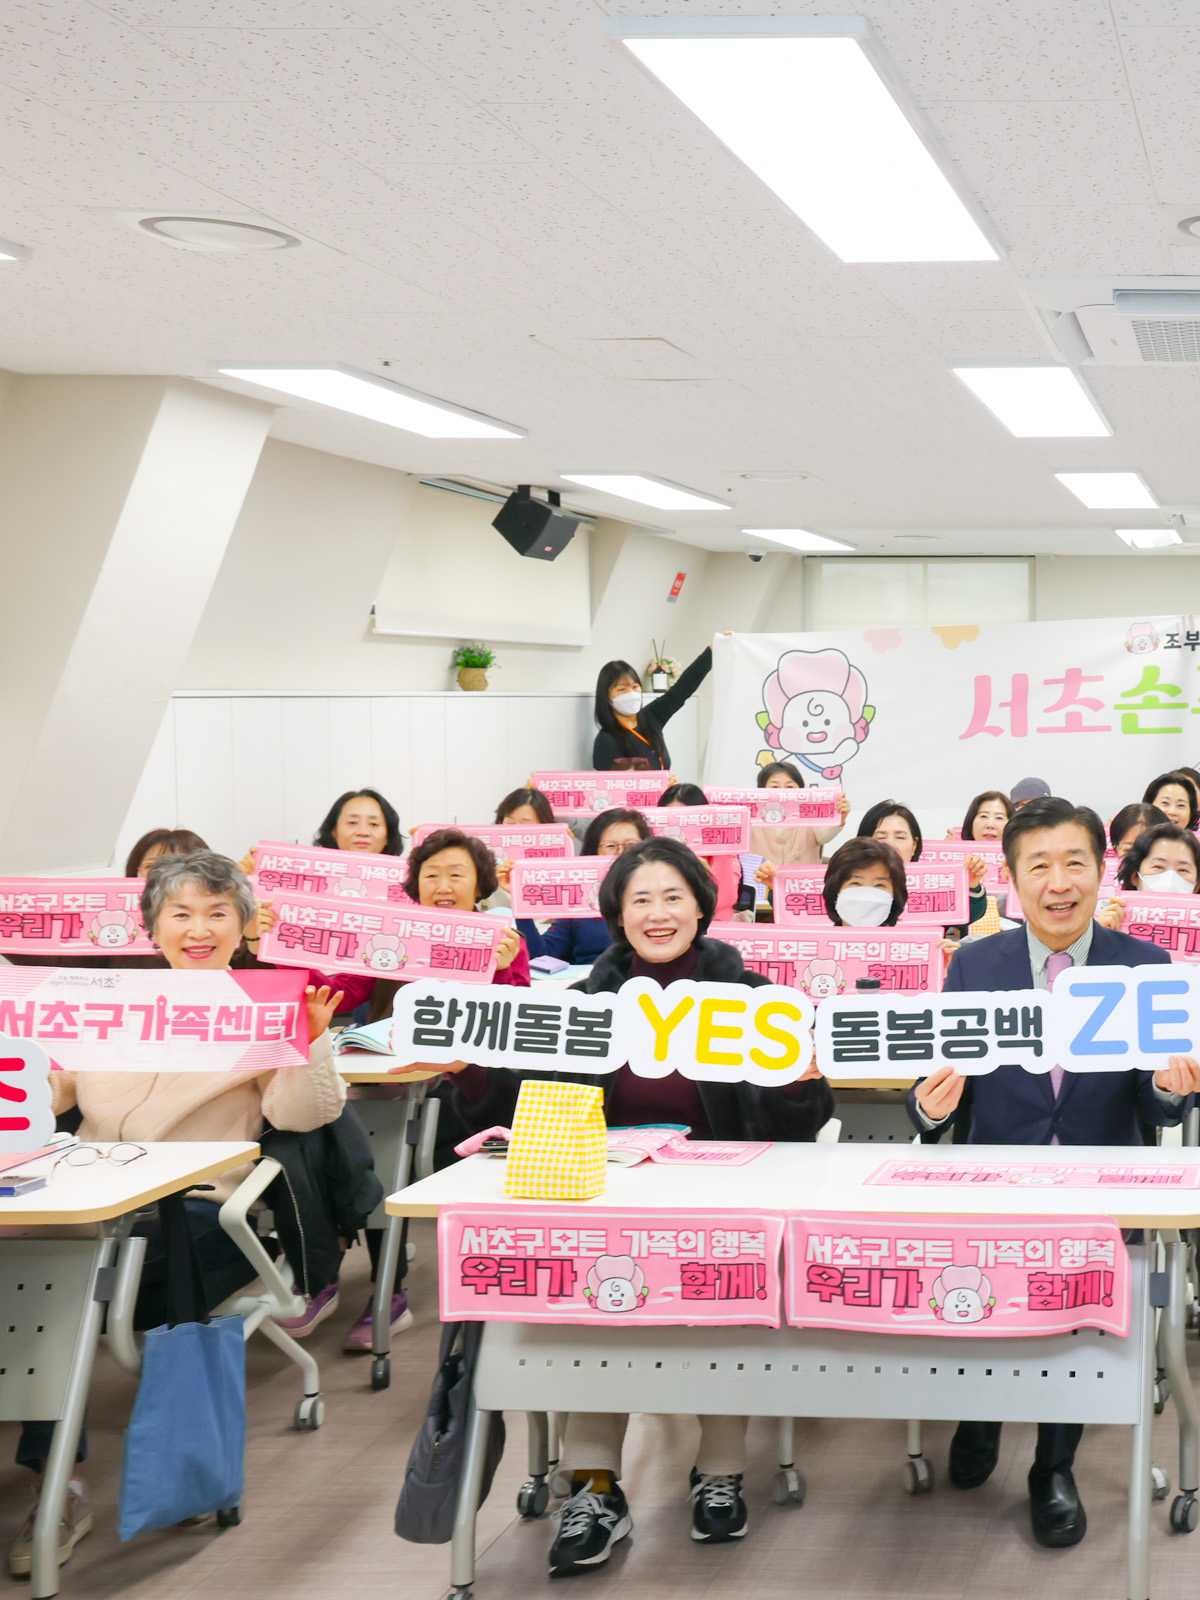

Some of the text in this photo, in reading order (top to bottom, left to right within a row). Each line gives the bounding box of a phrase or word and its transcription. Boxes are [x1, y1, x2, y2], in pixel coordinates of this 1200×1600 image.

[538, 780, 662, 791] 서초구 모든 가족의 행복
[711, 790, 835, 803] 서초구 모든 가족의 행복
[677, 814, 714, 827] 가족의
[716, 812, 742, 826] 행복
[800, 802, 836, 818] 함께!
[498, 834, 537, 847] 가족의
[540, 834, 565, 847] 행복
[702, 827, 742, 844] 함께!
[260, 854, 404, 880] 서초구 모든 가족의
[522, 868, 599, 884] 서초구 모든
[258, 870, 328, 892] 우리가
[924, 874, 955, 890] 행복
[62, 892, 107, 912] 모든
[522, 884, 584, 905] 우리가
[785, 891, 956, 915] 우리 함께!
[0, 912, 84, 940] 우리가
[279, 903, 495, 947] 서초구 모든 가족의 행복
[1130, 906, 1187, 926] 서초구
[278, 922, 492, 973] 우리가 함께!
[721, 938, 930, 962] 초구 모든 가족의 행복
[0, 995, 299, 1042] 서초구가족센터
[412, 993, 802, 1070] 함께돌봄 YES
[831, 1005, 1043, 1062] 돌봄공백
[459, 1225, 767, 1260] 서초구 모든 가족의 행복
[804, 1234, 1117, 1268] 서초구 모든 가족의 행복
[459, 1257, 768, 1300] 우리가 함께!
[806, 1264, 1116, 1311] 우리가 함께!
